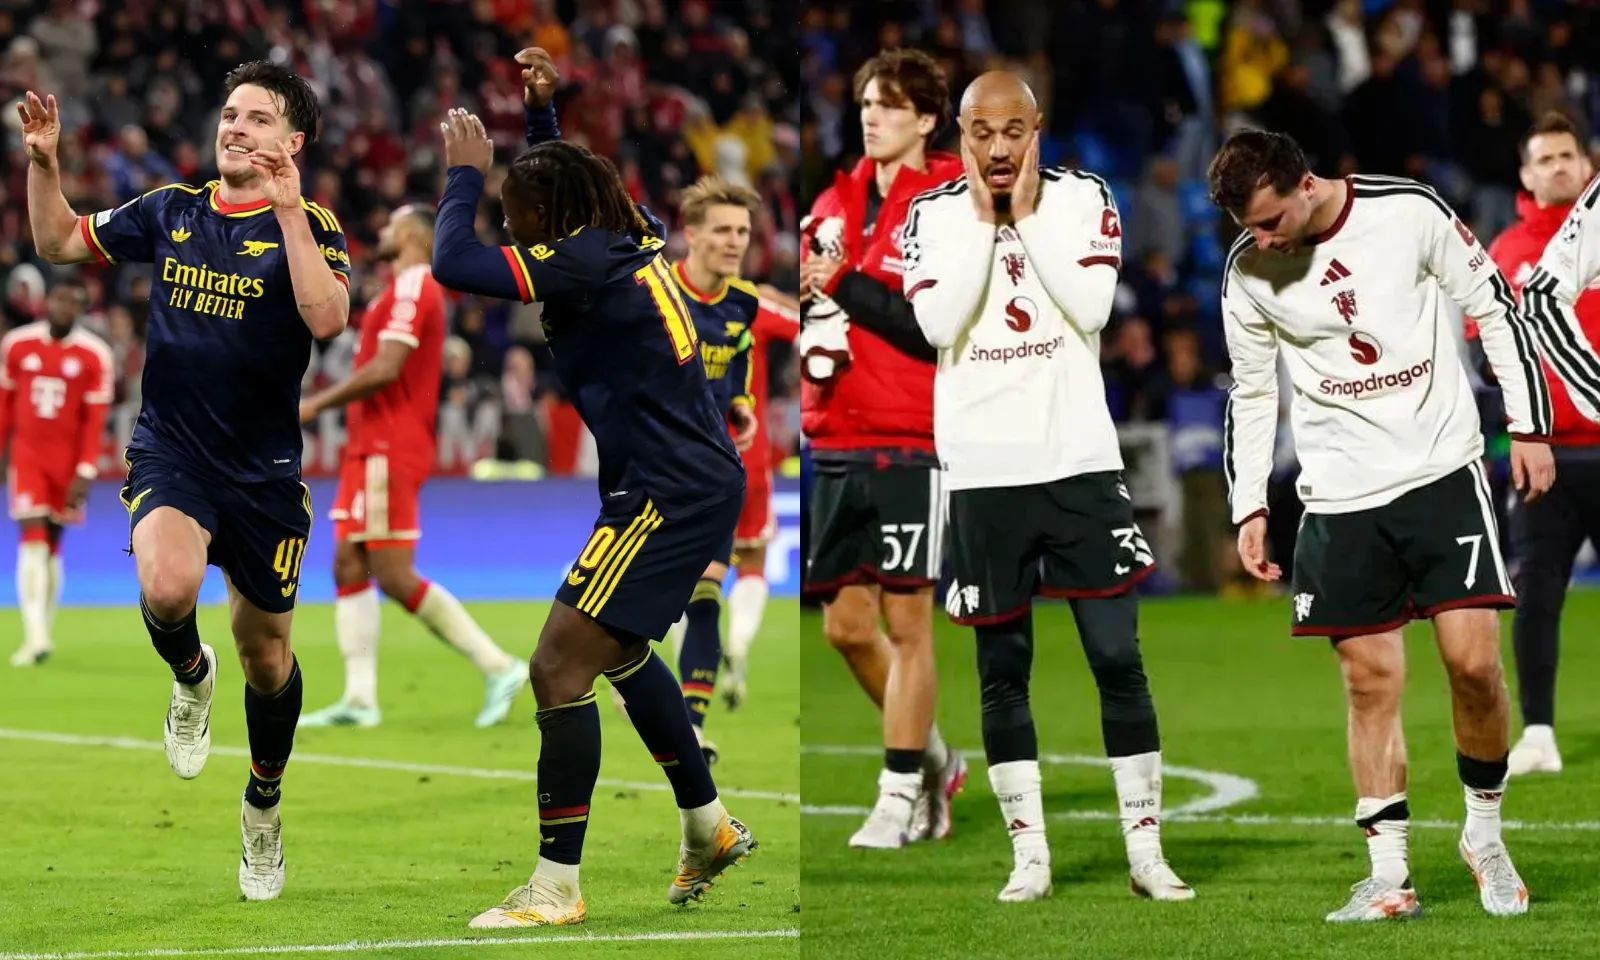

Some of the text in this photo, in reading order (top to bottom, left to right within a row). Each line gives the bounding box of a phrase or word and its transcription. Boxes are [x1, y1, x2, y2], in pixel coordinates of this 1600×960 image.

[163, 256, 264, 298] Emirates
[169, 287, 245, 320] FLY BETTER
[1317, 358, 1434, 399] Snapdragon
[273, 537, 306, 581] 41
[881, 523, 925, 571] 57
[1455, 534, 1483, 590] 7
